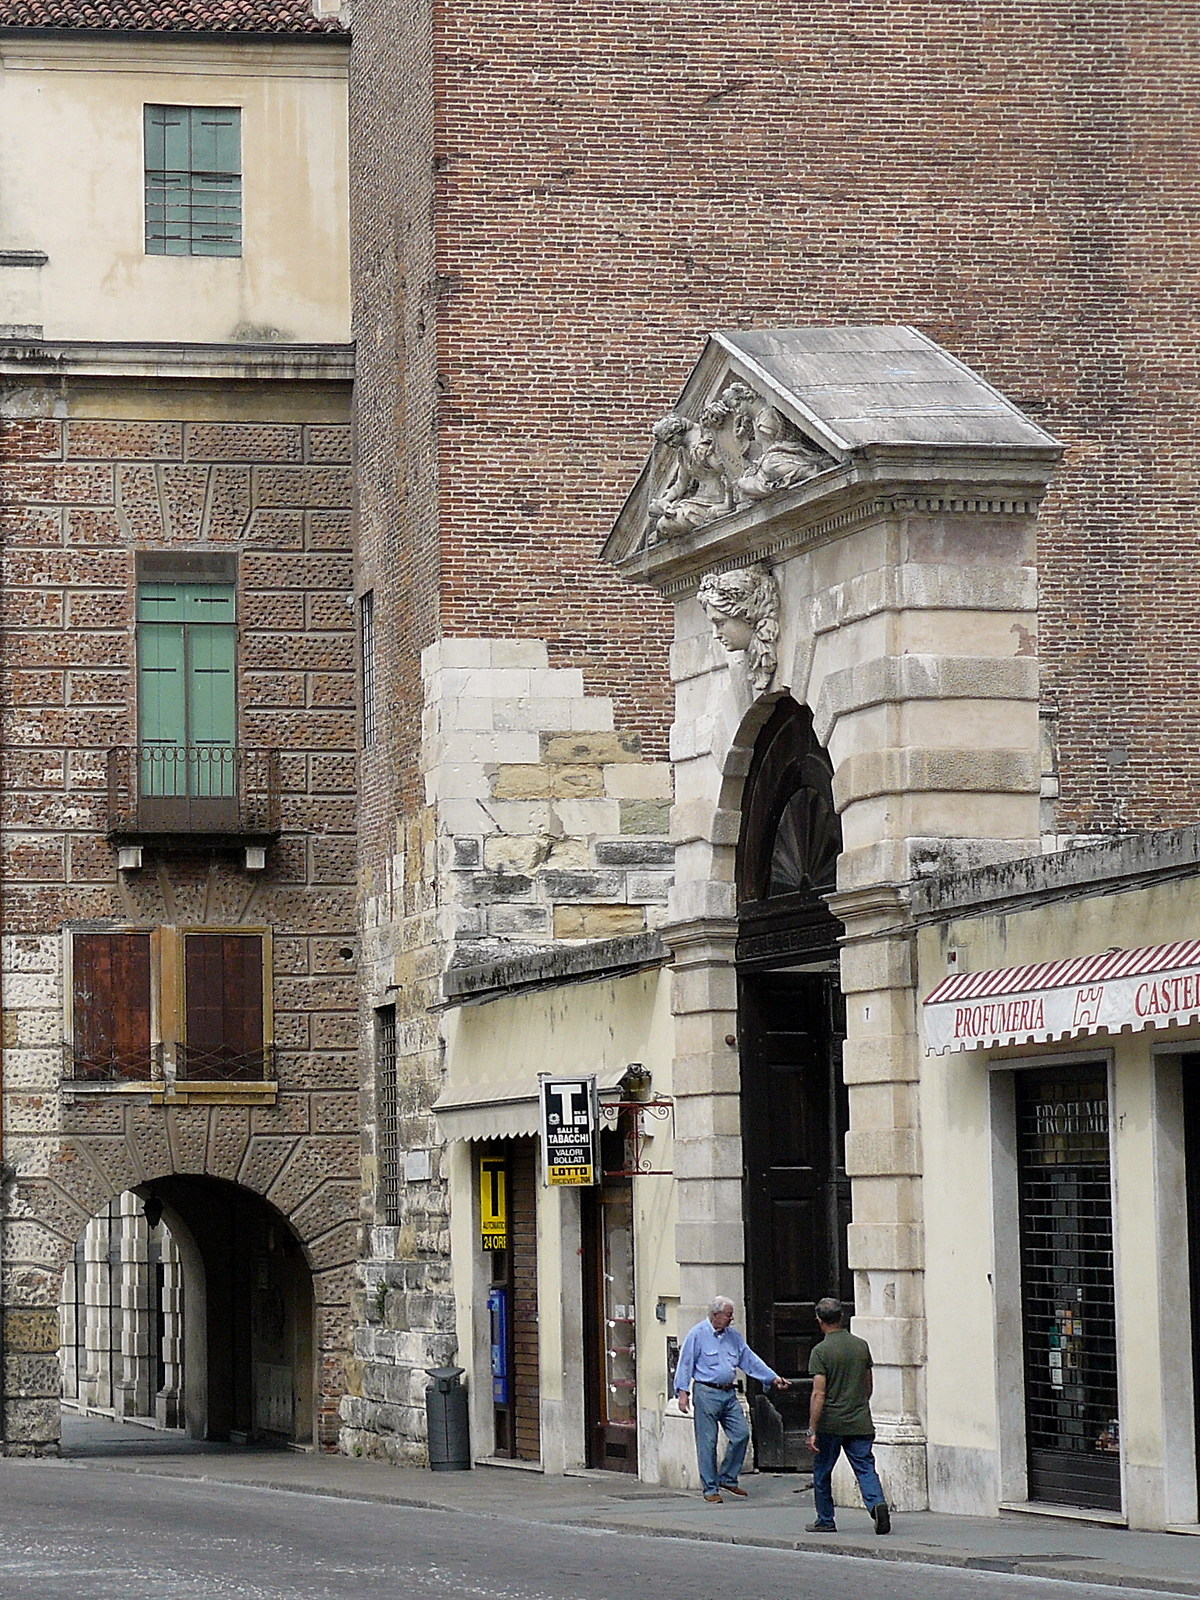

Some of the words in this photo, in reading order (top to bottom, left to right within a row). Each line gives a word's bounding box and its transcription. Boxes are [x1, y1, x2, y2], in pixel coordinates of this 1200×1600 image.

[954, 997, 1045, 1038] PROFUMERIA
[550, 1084, 582, 1126] T
[548, 1133, 589, 1144] TABACCHI
[555, 1148, 583, 1156] VALORI
[553, 1156, 585, 1164] BOLLATI
[552, 1167, 588, 1176] LOTTO
[483, 1162, 505, 1217] T
[484, 1236, 492, 1249] 24
